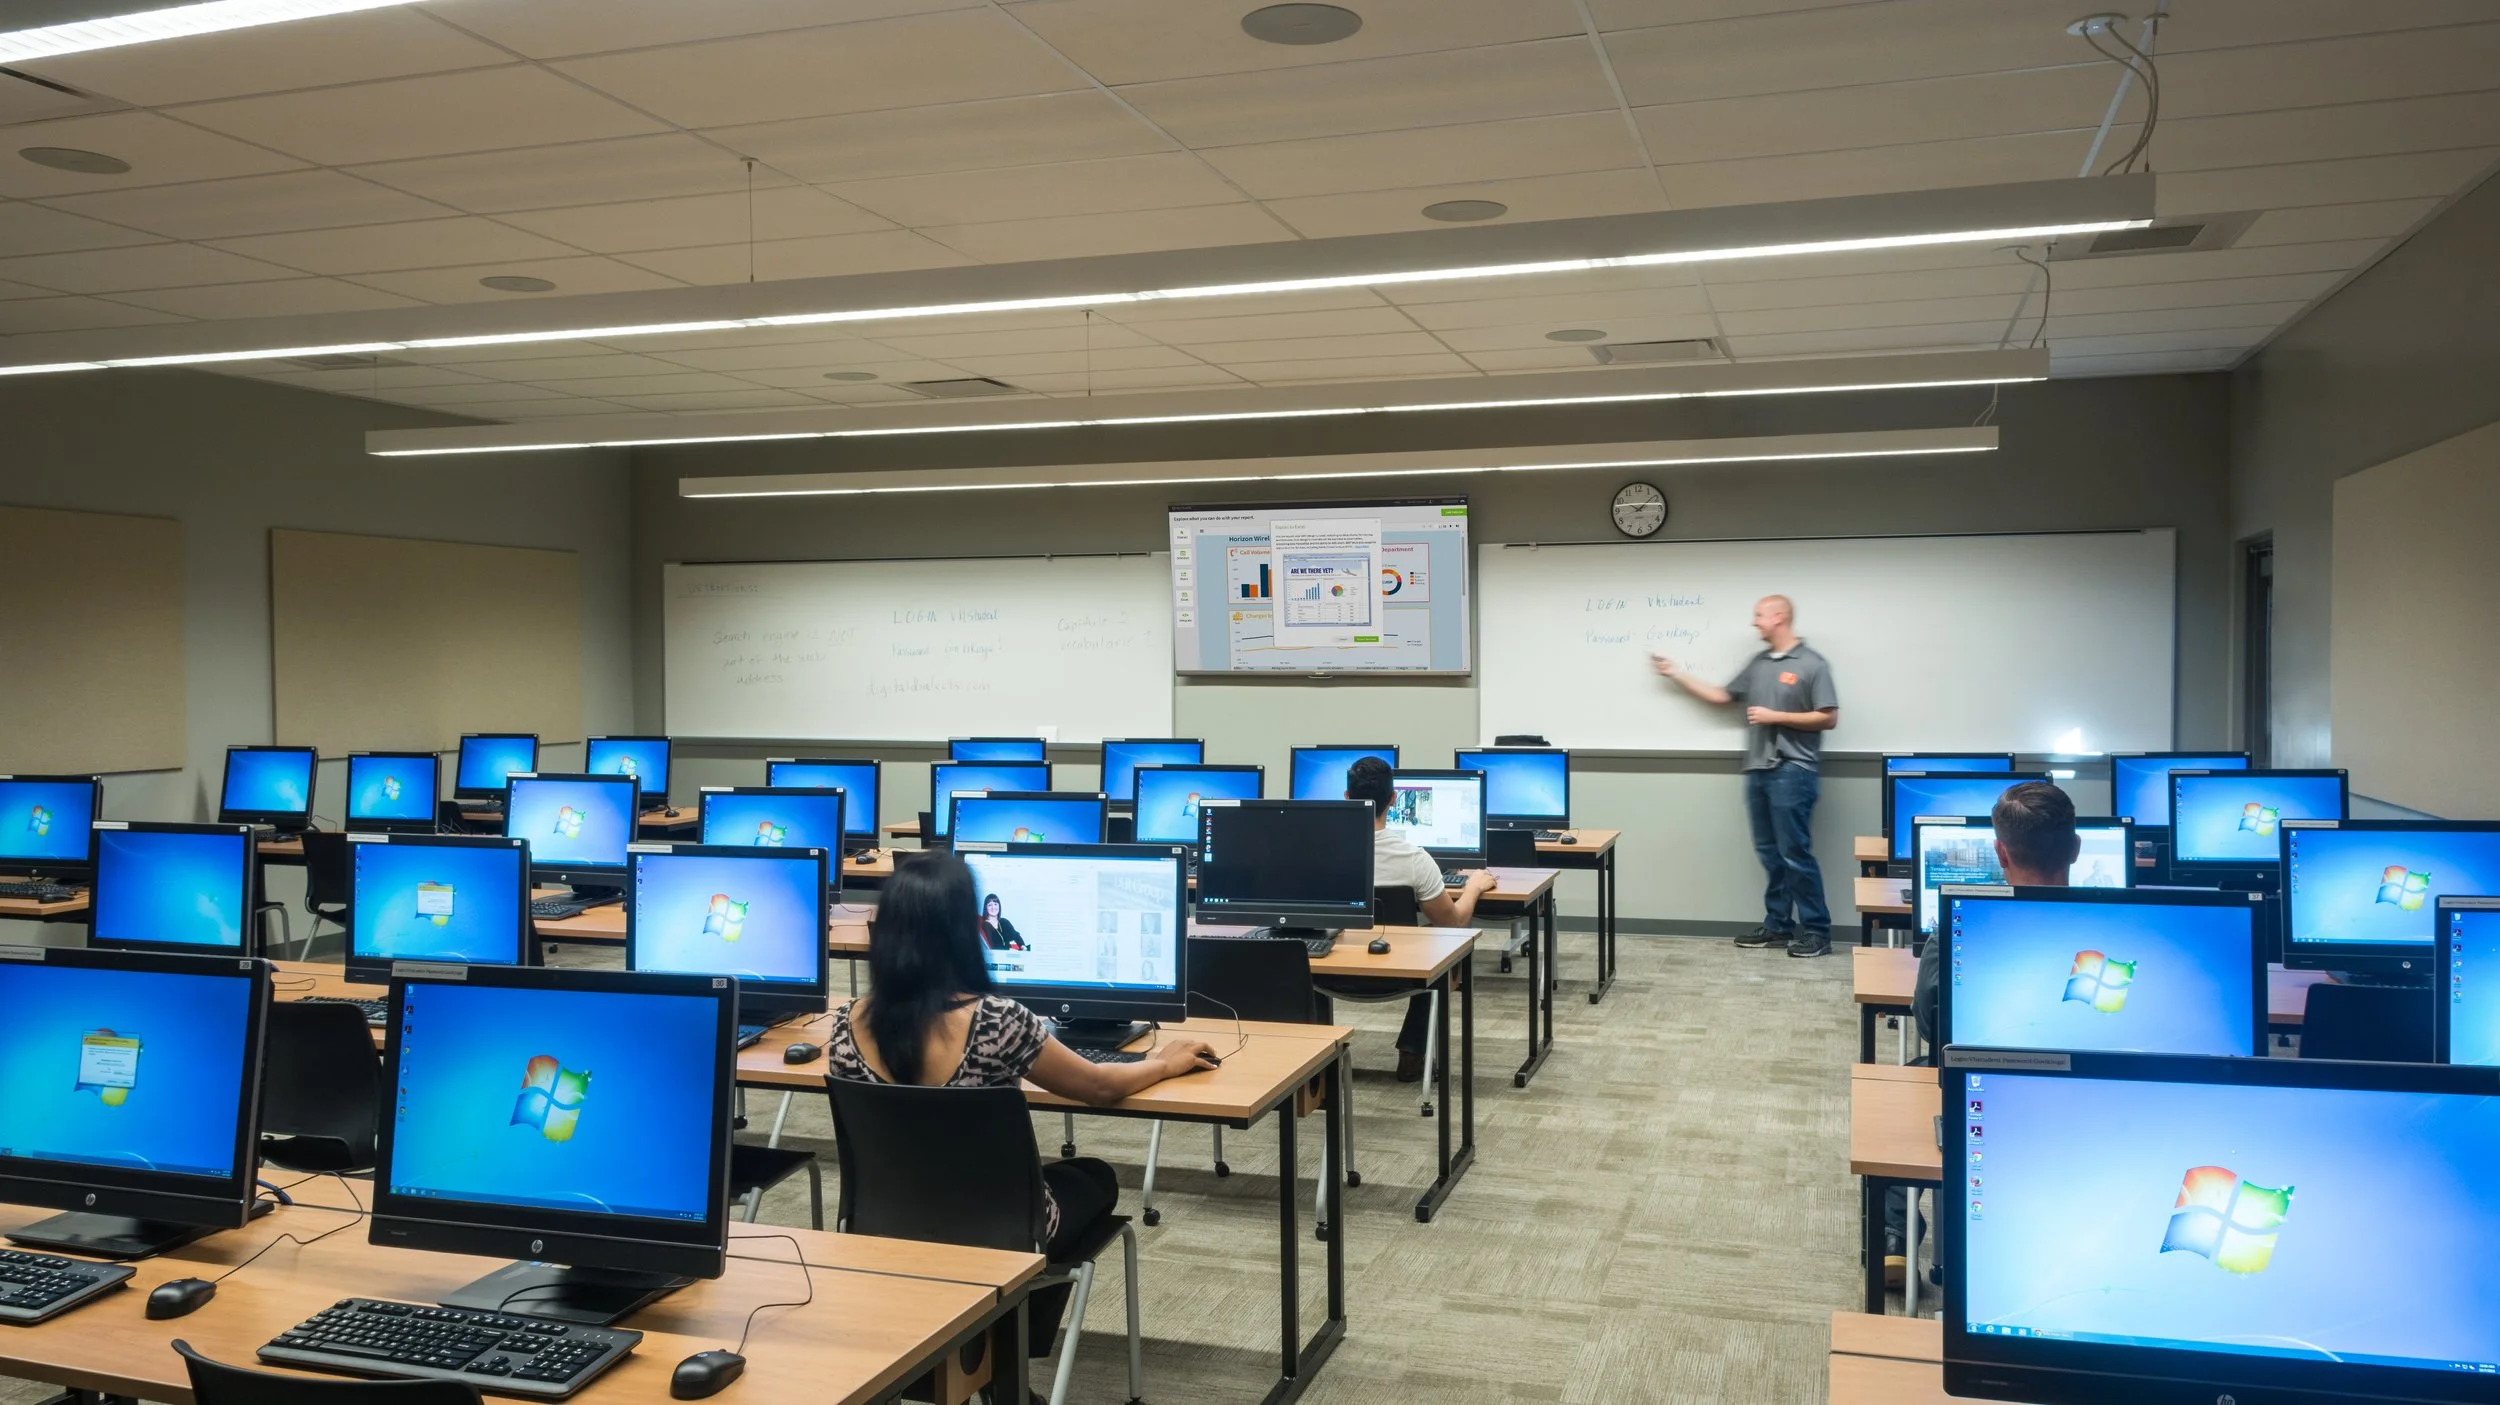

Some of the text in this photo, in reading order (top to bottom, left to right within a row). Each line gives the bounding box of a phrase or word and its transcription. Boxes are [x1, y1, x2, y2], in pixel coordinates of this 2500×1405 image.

[1615, 507, 1620, 515] 9
[1618, 517, 1624, 525] 8
[1627, 524, 1632, 532] 7
[1637, 526, 1643, 534] 6
[1585, 597, 1628, 612] LOGIN
[893, 609, 937, 624] LOGIN
[712, 630, 751, 645] Search
[763, 631, 800, 648] engine
[721, 653, 743, 671] part
[748, 654, 763, 665] of
[772, 652, 792, 664] the
[736, 673, 784, 685] address
